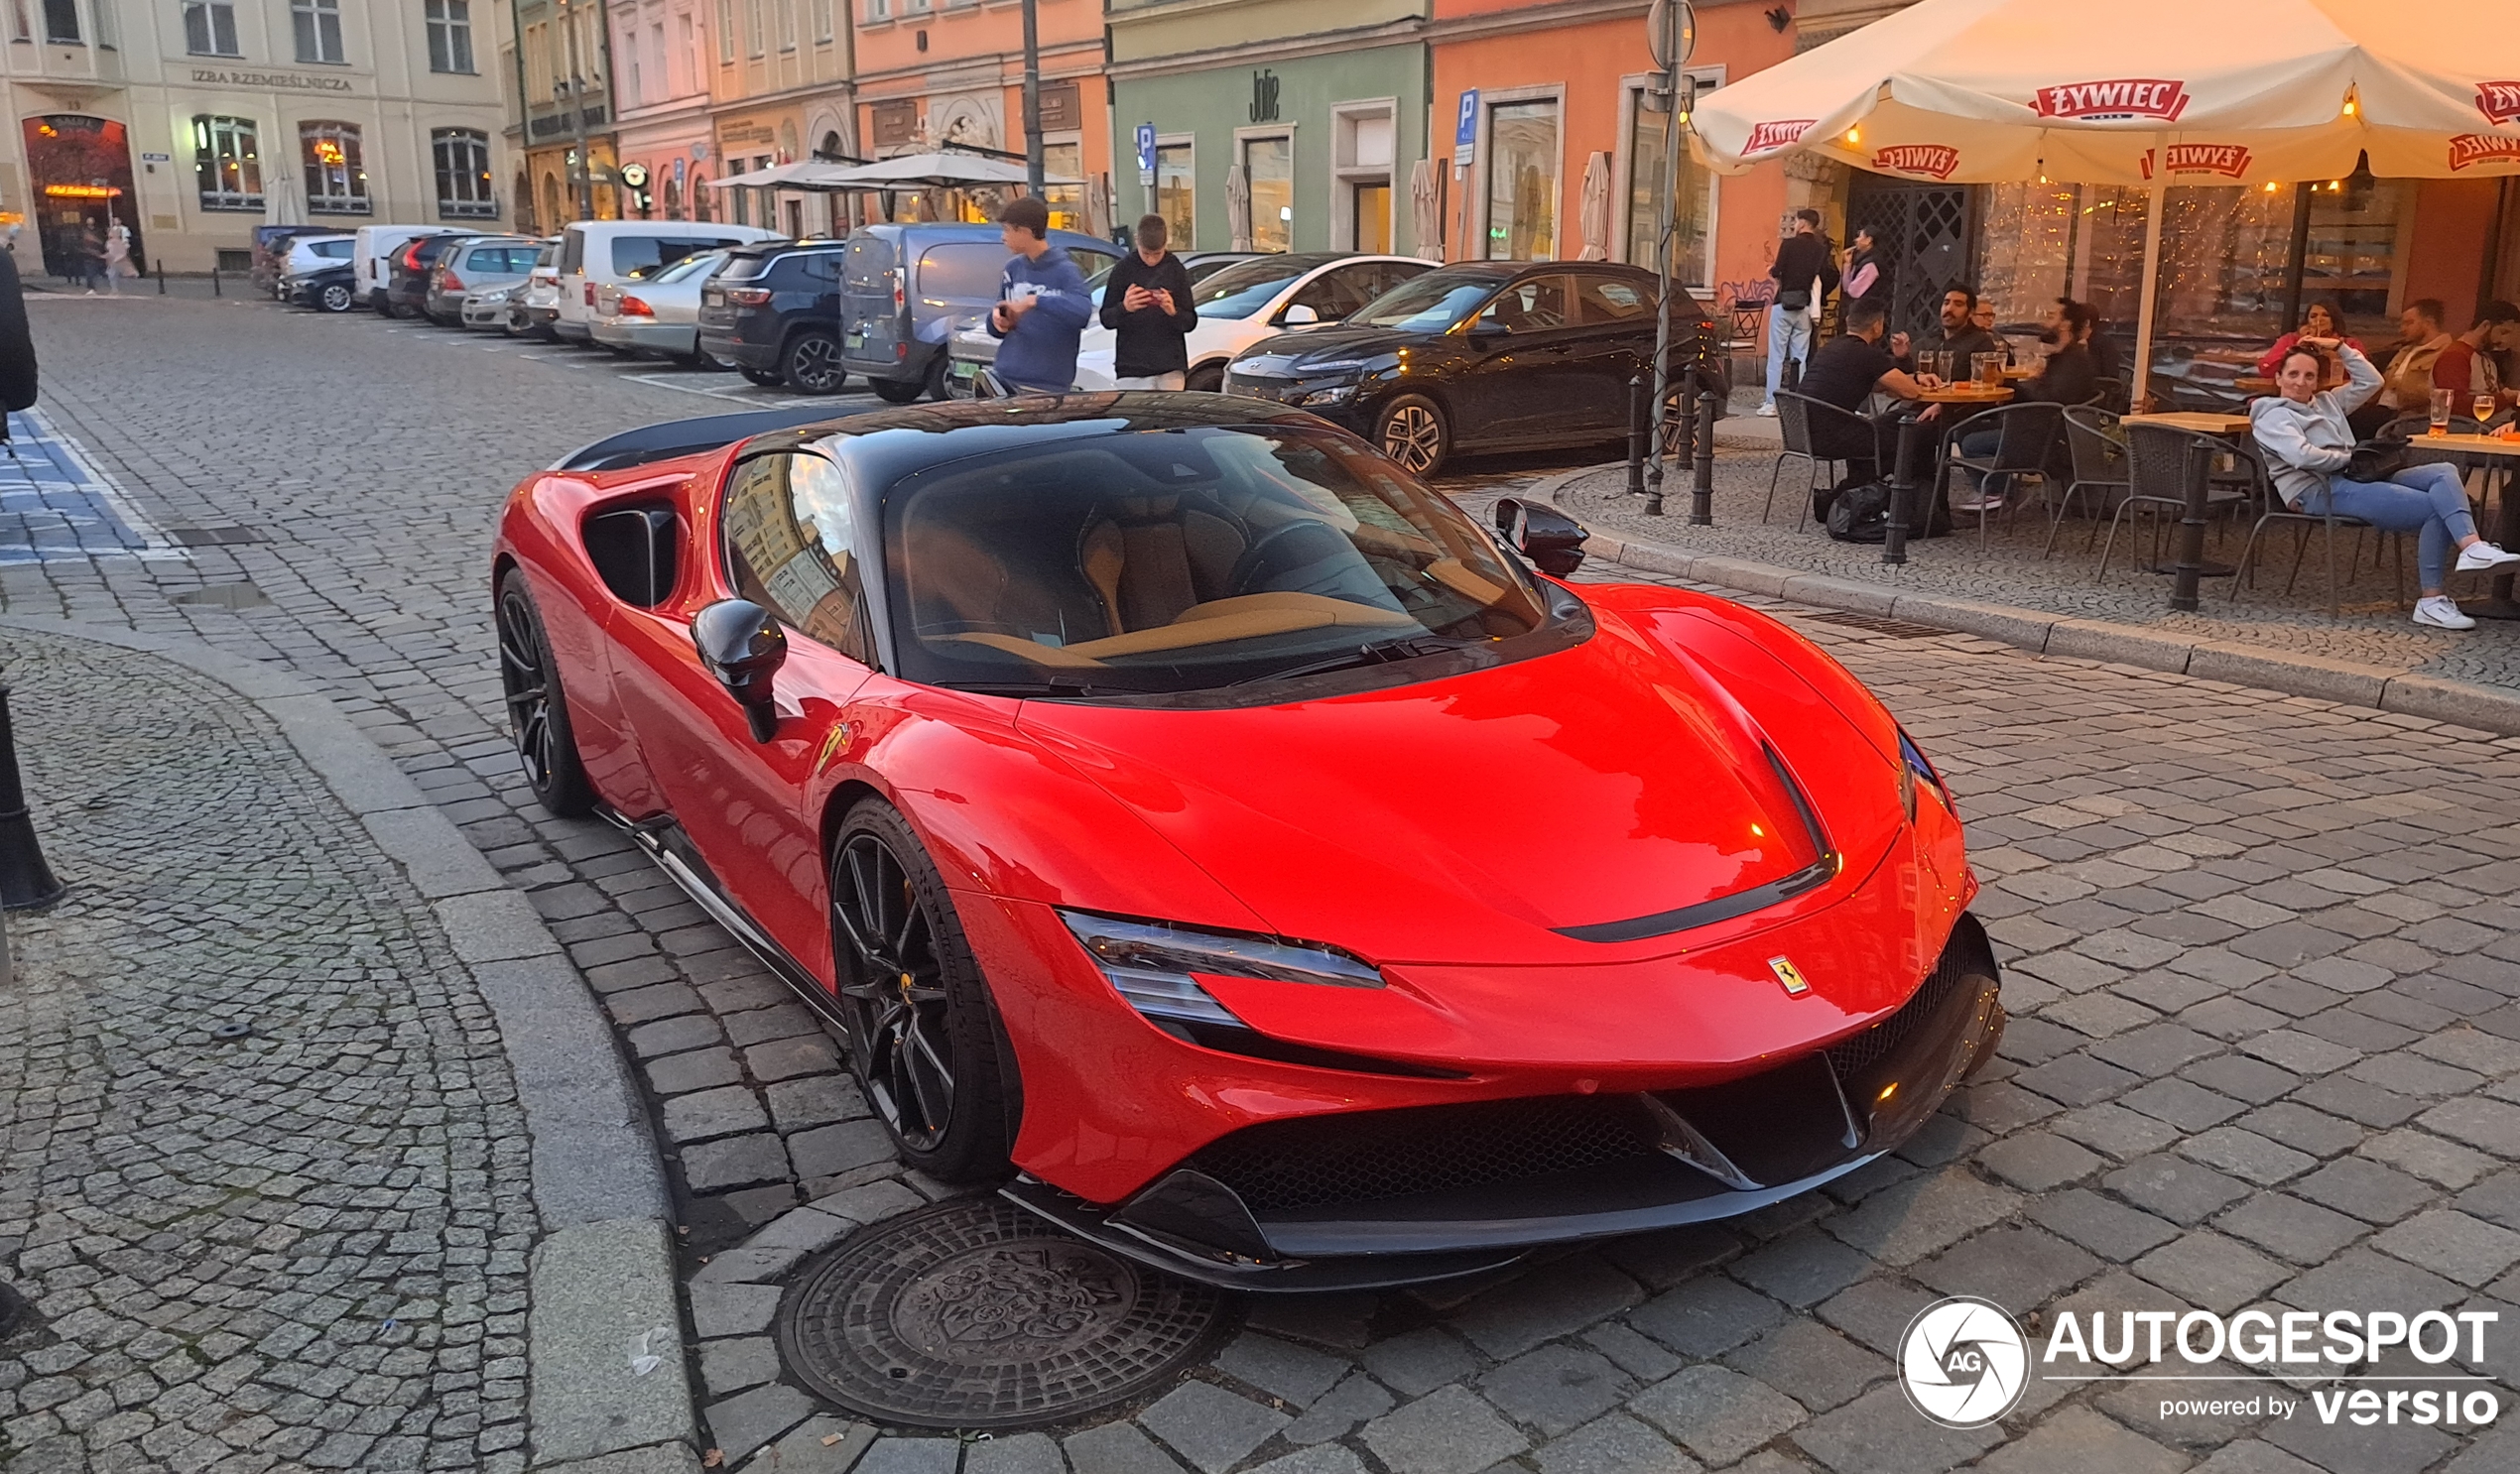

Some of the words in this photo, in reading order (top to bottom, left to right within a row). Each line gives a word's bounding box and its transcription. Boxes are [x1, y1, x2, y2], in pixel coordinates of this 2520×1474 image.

[192, 69, 228, 83] IZBA
[231, 72, 352, 90] RZEMIEŚLNICZA
[1460, 94, 1474, 128] P
[2050, 82, 2171, 115] ŻYWIEC
[1140, 128, 1151, 156] P
